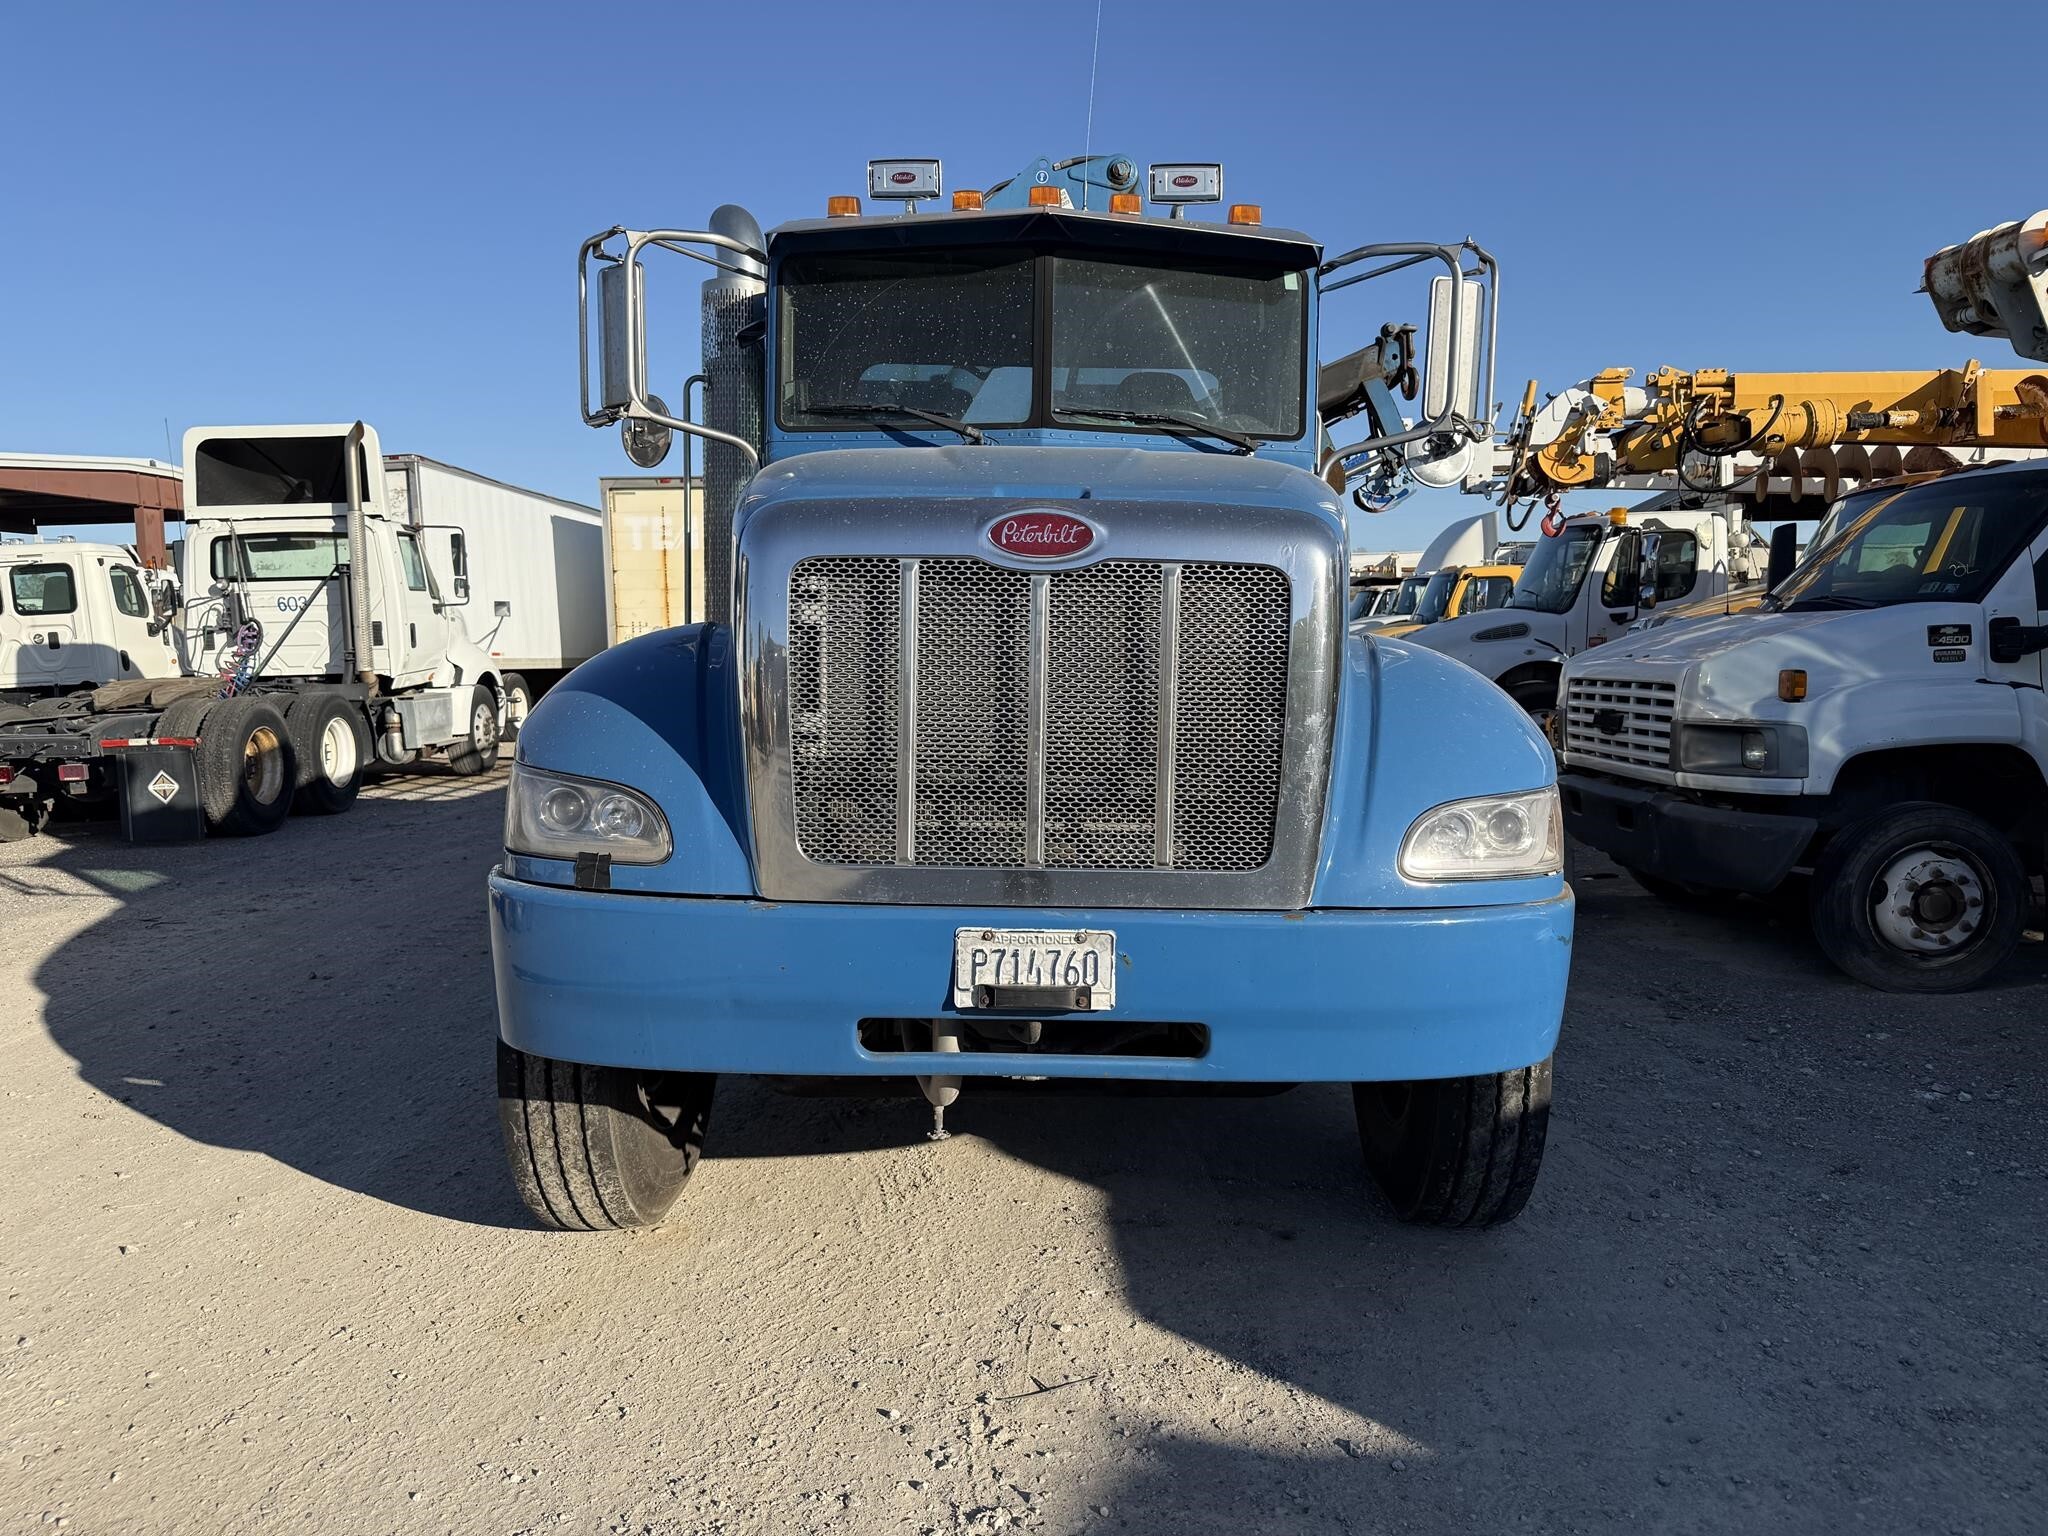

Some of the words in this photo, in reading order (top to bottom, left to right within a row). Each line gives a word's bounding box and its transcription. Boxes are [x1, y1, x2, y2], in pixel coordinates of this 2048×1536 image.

[1001, 520, 1086, 545] Peterbilt
[277, 596, 308, 611] 603
[971, 949, 1099, 987] P714760
